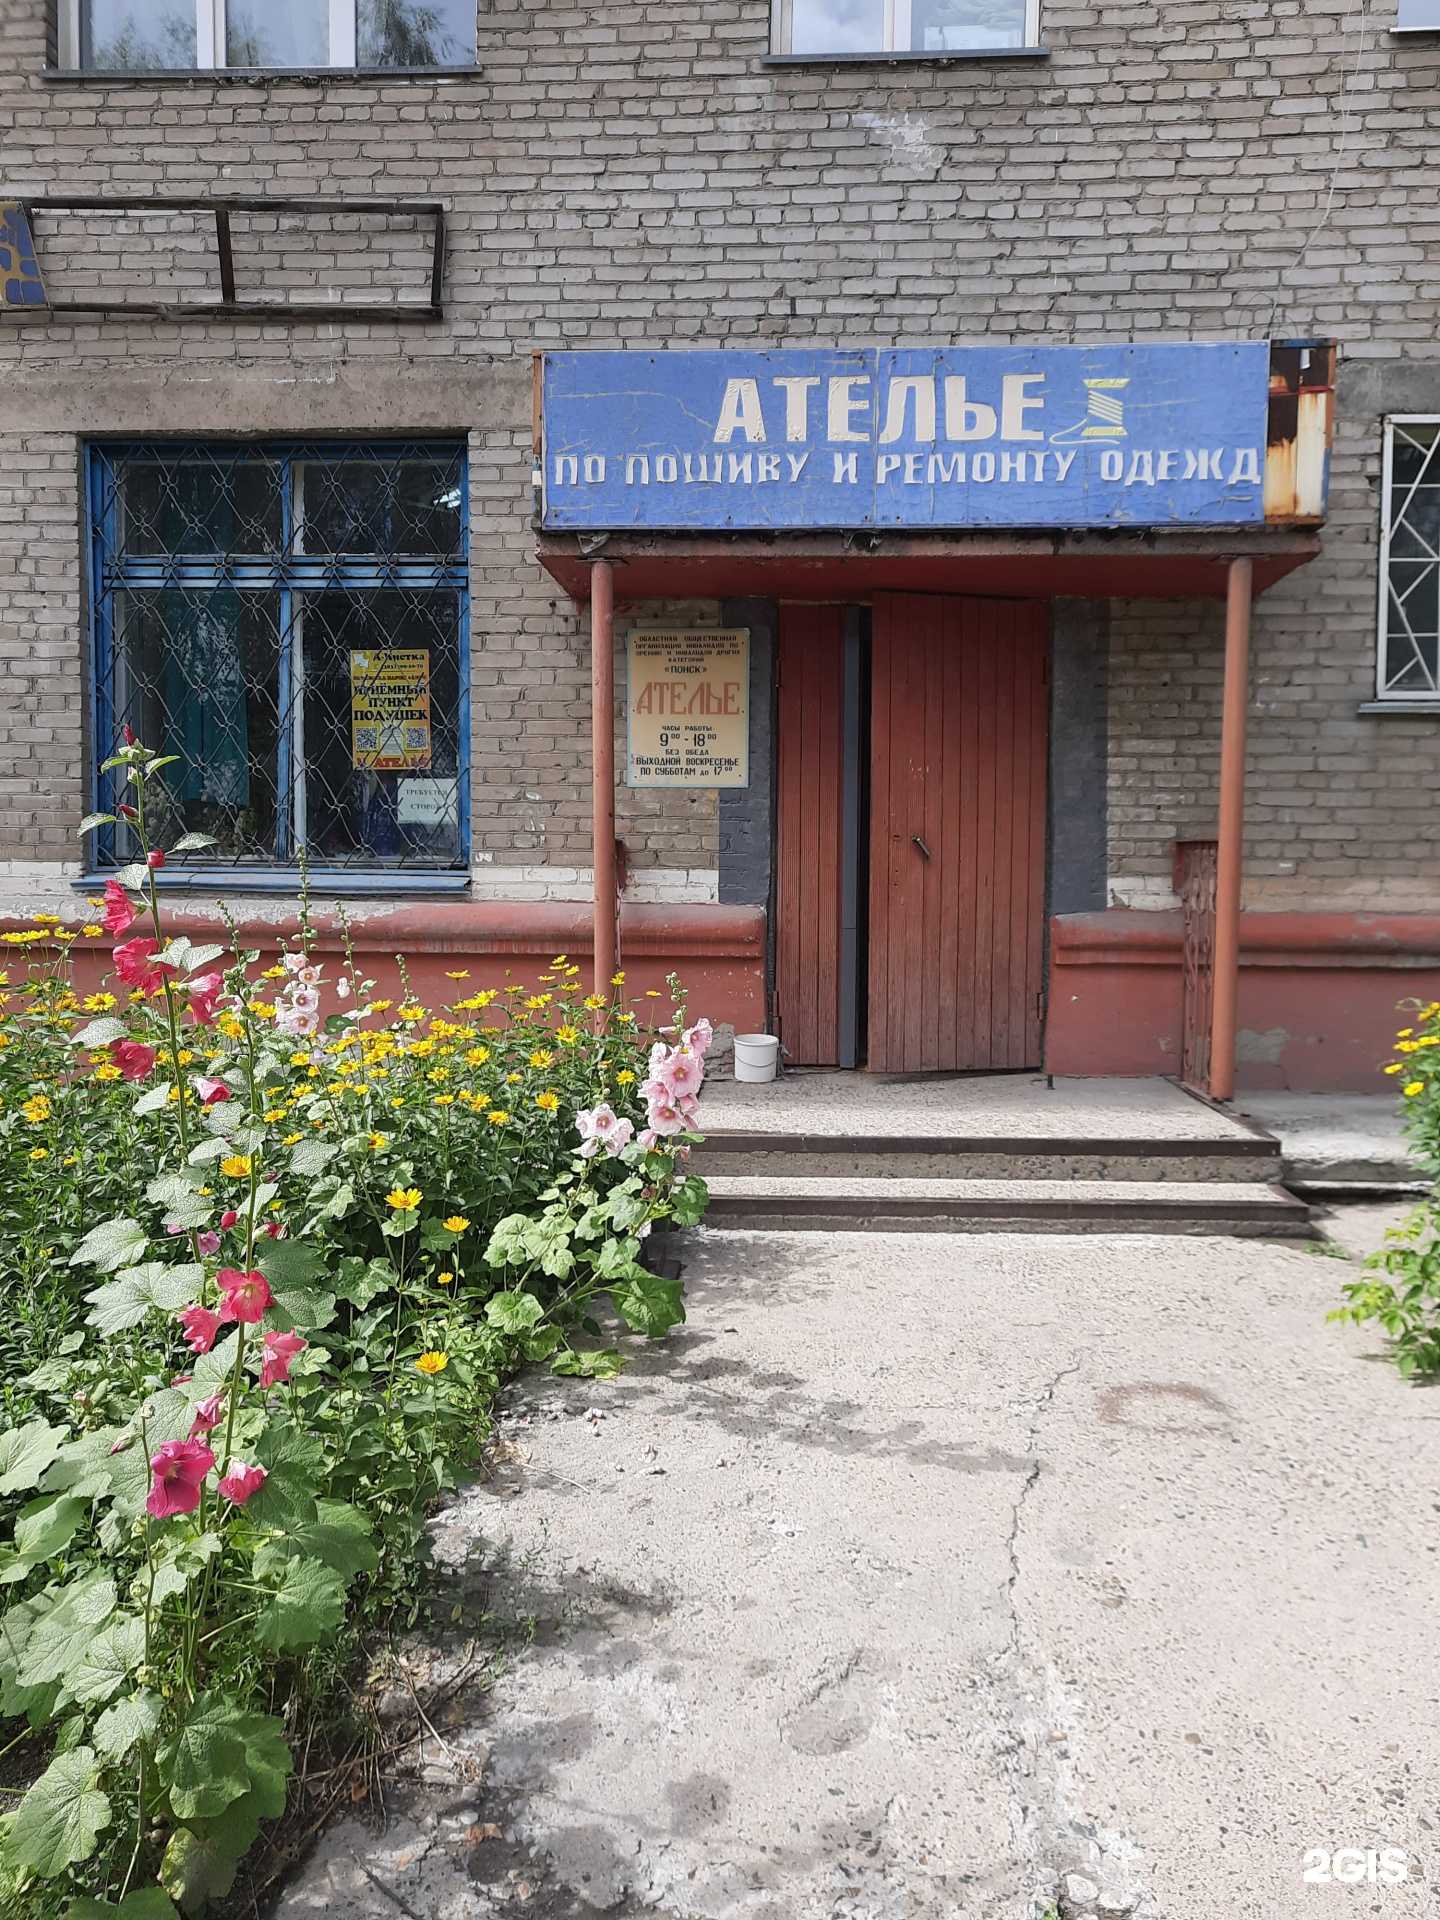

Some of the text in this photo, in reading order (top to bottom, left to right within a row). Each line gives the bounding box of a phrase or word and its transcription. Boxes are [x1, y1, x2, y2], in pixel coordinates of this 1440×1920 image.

[713, 372, 1046, 444] АТЕЛЬЕ
[554, 447, 1262, 487] ПО ПОШИВУ И РЕМОНТУ ОДЕЖД
[368, 697, 414, 708] ПУНКТ
[636, 681, 740, 715] АТЕЛЬЕ
[354, 709, 428, 722] ПОДУШЕК
[665, 748, 710, 756] БЕЗ ОБЕДА
[636, 757, 740, 766] ВЫХОДНОЙ ВОСКРЕСЕНЬЕ
[640, 767, 651, 776] ПО
[655, 767, 696, 776] СУББОТАМ
